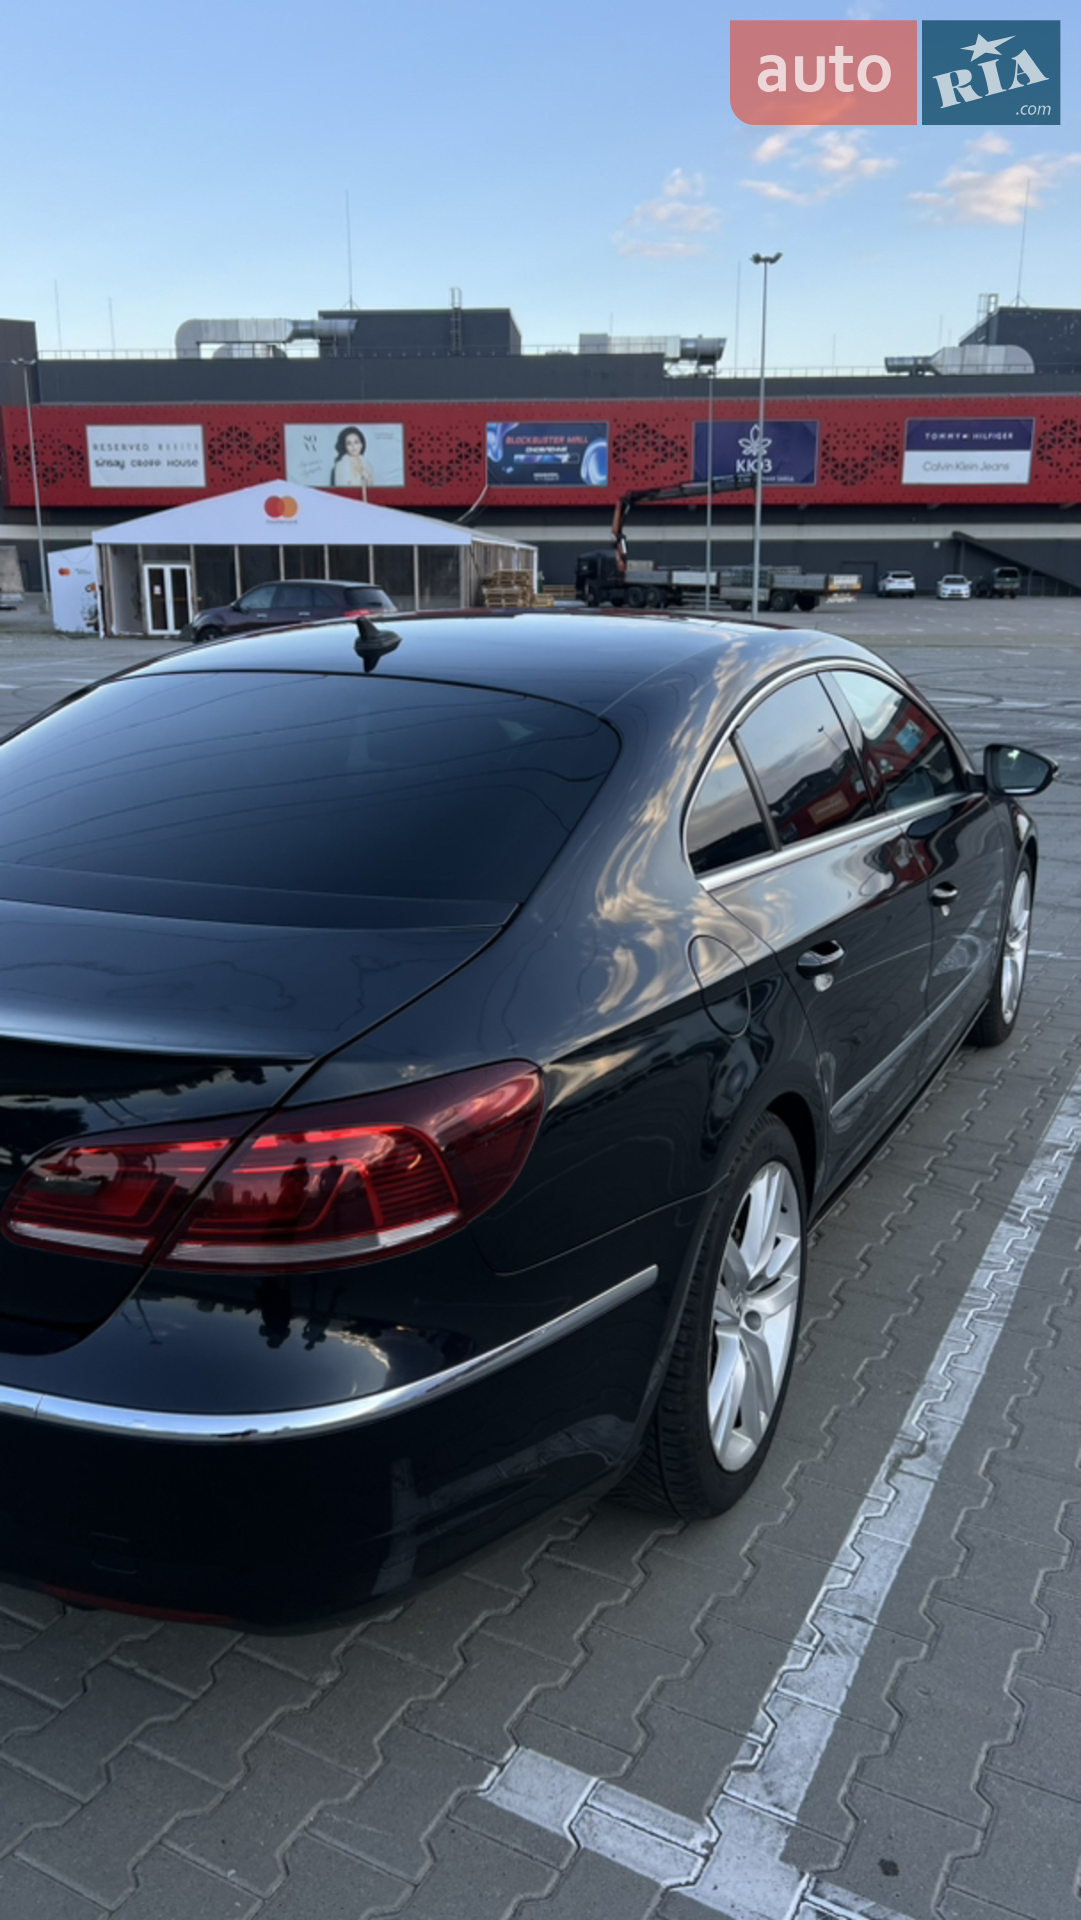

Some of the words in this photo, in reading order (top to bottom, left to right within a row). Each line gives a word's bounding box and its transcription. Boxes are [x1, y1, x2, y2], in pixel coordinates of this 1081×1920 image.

[505, 435, 566, 445] BLOCKBUSTER
[567, 435, 589, 445] MALL
[925, 432, 961, 441] TOMMY
[972, 432, 1014, 441] HILFIGER
[92, 443, 150, 452] RESERVED
[922, 461, 954, 472] Calvin
[956, 461, 979, 472] Klein
[980, 461, 1010, 472] Jeans
